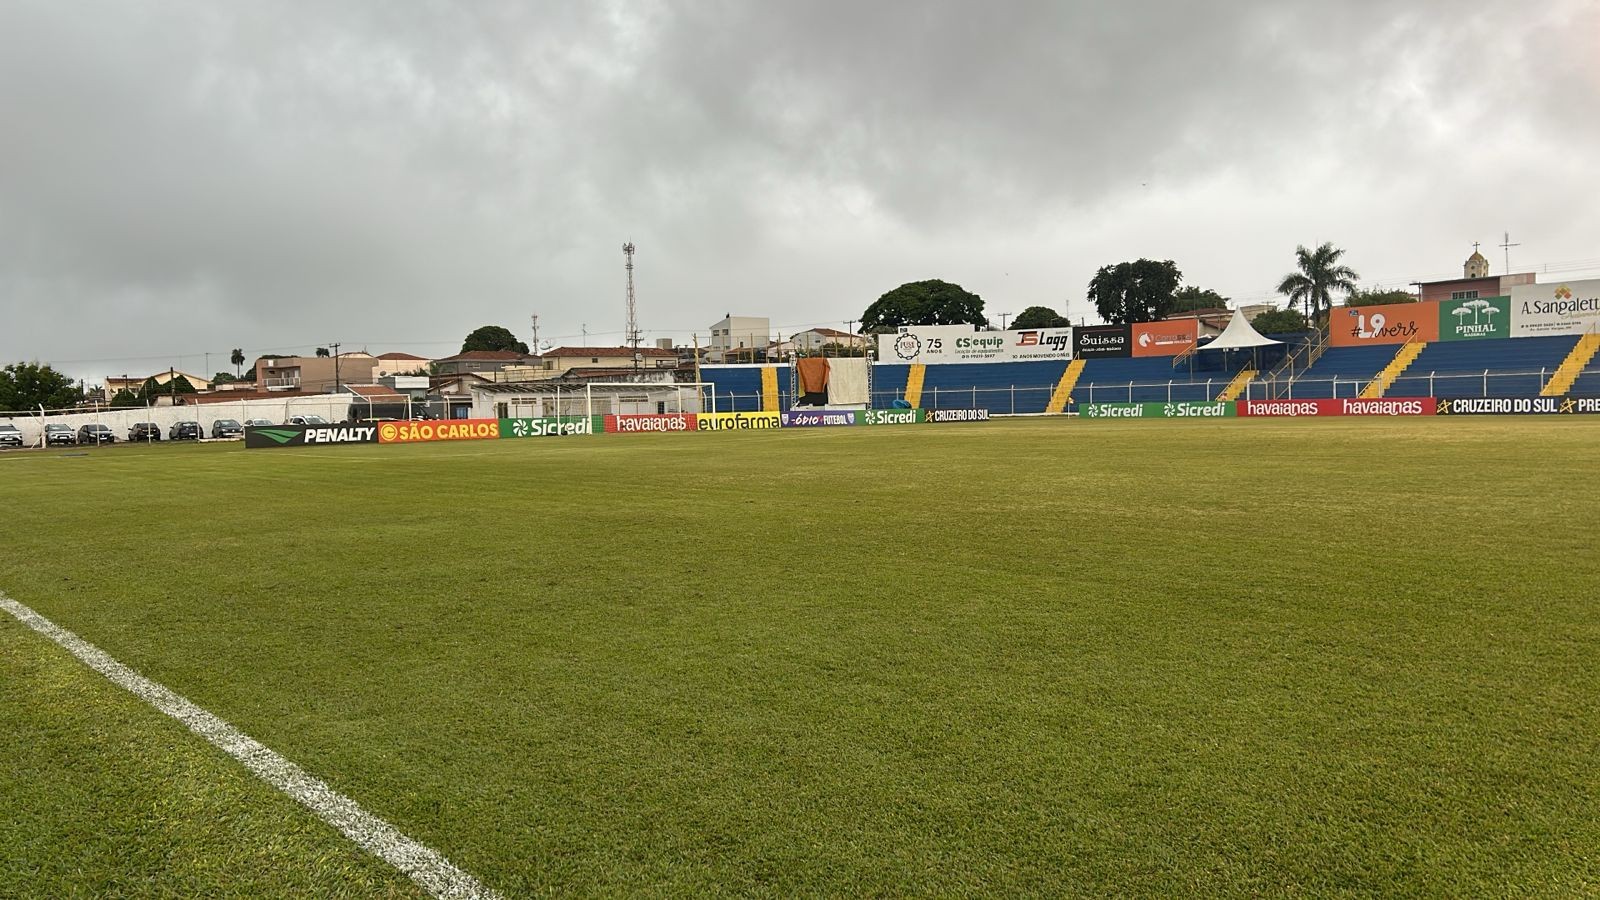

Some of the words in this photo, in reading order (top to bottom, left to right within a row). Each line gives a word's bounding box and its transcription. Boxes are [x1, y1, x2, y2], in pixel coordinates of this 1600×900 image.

[1456, 324, 1497, 334] PINHAL
[926, 338, 943, 349] 75
[1080, 334, 1125, 345] Suissa
[1100, 404, 1144, 417] Sicredi
[1177, 402, 1225, 417] Sicredi
[1247, 401, 1318, 417] havaianas
[1343, 399, 1422, 416] havaianas
[1453, 399, 1511, 413] CRUZEIRO
[1514, 399, 1531, 412] DO
[1533, 399, 1558, 412] SUL
[1578, 398, 1600, 412] PRE
[698, 413, 779, 430] eurofarma
[877, 410, 916, 424] Sicredi
[934, 410, 967, 422] CRUZEIRO
[968, 409, 976, 420] DO
[977, 409, 989, 420] SUL
[399, 422, 433, 439] SÃO
[436, 423, 498, 438] CARLOS
[531, 418, 592, 436] Sicredi
[616, 415, 686, 432] havaianas
[304, 427, 375, 443] PENALTY
